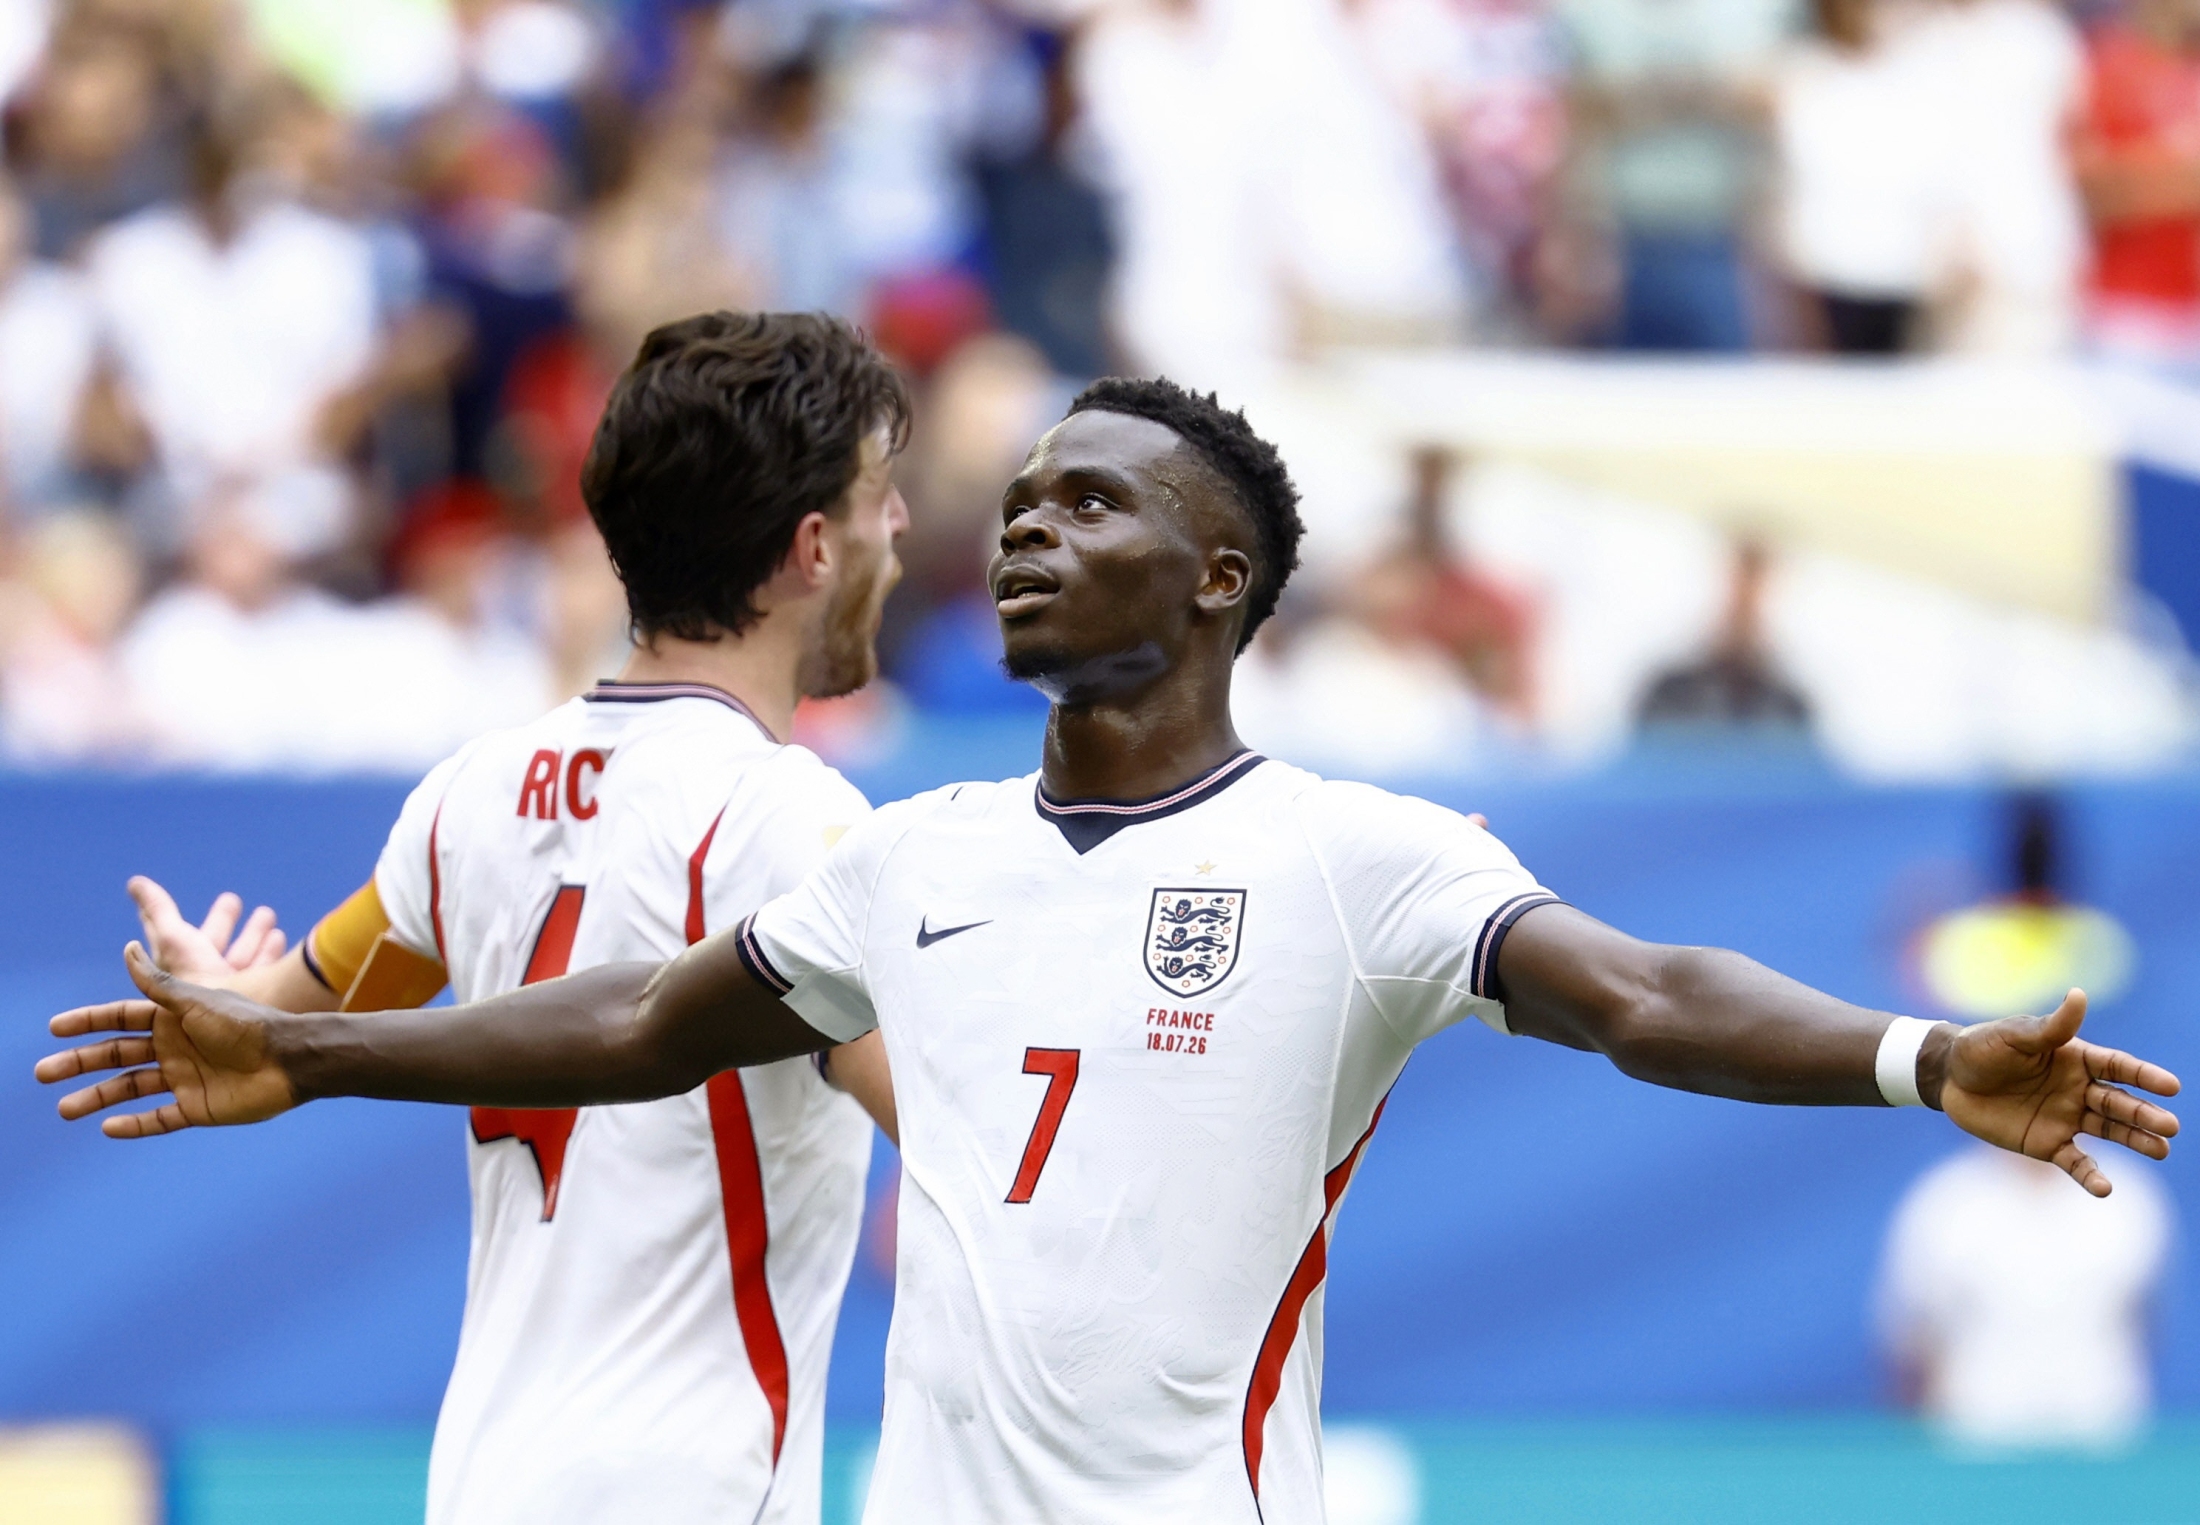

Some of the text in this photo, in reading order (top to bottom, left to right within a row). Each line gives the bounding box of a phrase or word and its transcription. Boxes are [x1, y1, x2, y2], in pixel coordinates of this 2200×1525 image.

[1147, 1008, 1214, 1031] FRANCE
[1147, 1032, 1207, 1054] 18.07.26
[1004, 1046, 1081, 1204] 7
